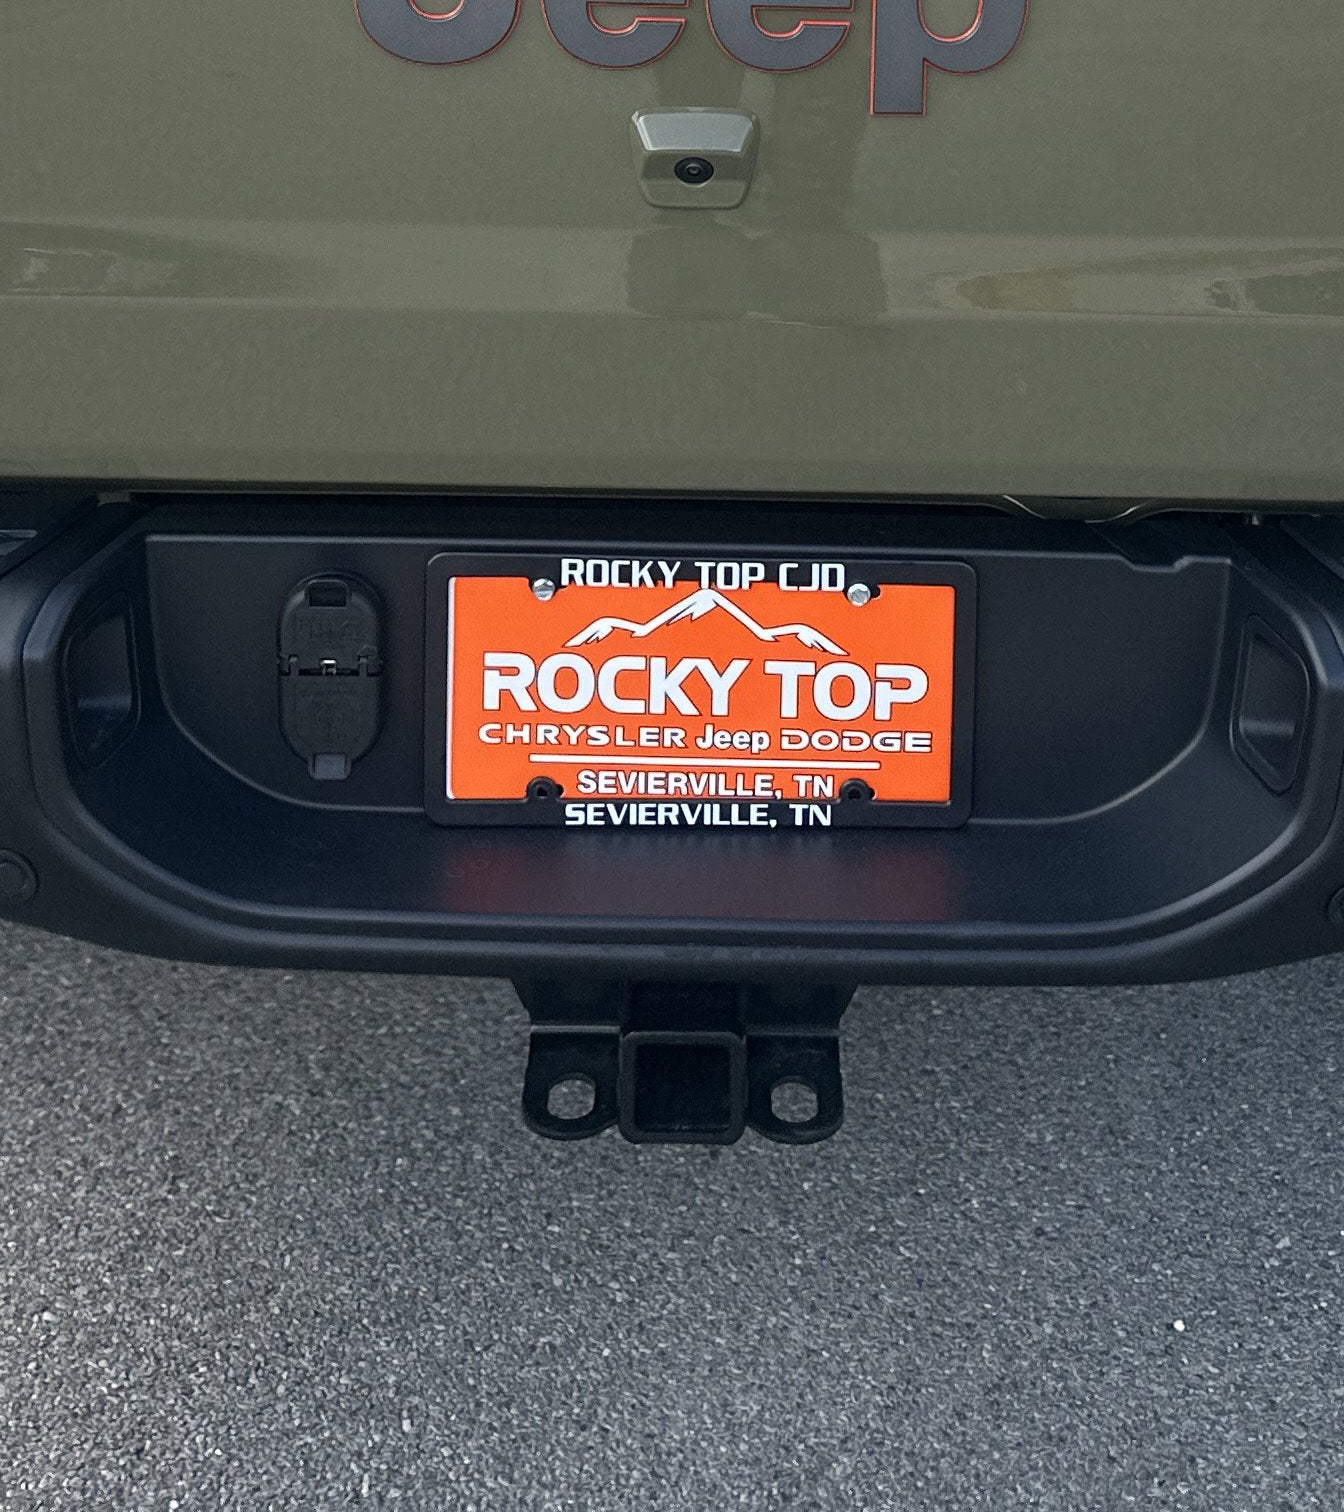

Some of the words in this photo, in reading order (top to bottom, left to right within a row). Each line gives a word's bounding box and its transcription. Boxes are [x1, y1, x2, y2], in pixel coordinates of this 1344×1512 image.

[560, 558, 681, 589] ROCKY
[694, 561, 766, 592] TOP
[778, 562, 846, 592] CJD
[482, 651, 753, 717] ROCKY
[763, 659, 930, 722] TOP
[478, 722, 688, 748] CHRYSLER
[694, 723, 771, 755] Jeep
[779, 728, 933, 754] DODGE
[576, 769, 784, 800] SEVIERVILLE,
[792, 773, 835, 799] TN
[564, 802, 778, 829] SEVIERVILLE,
[789, 803, 832, 827] TN
